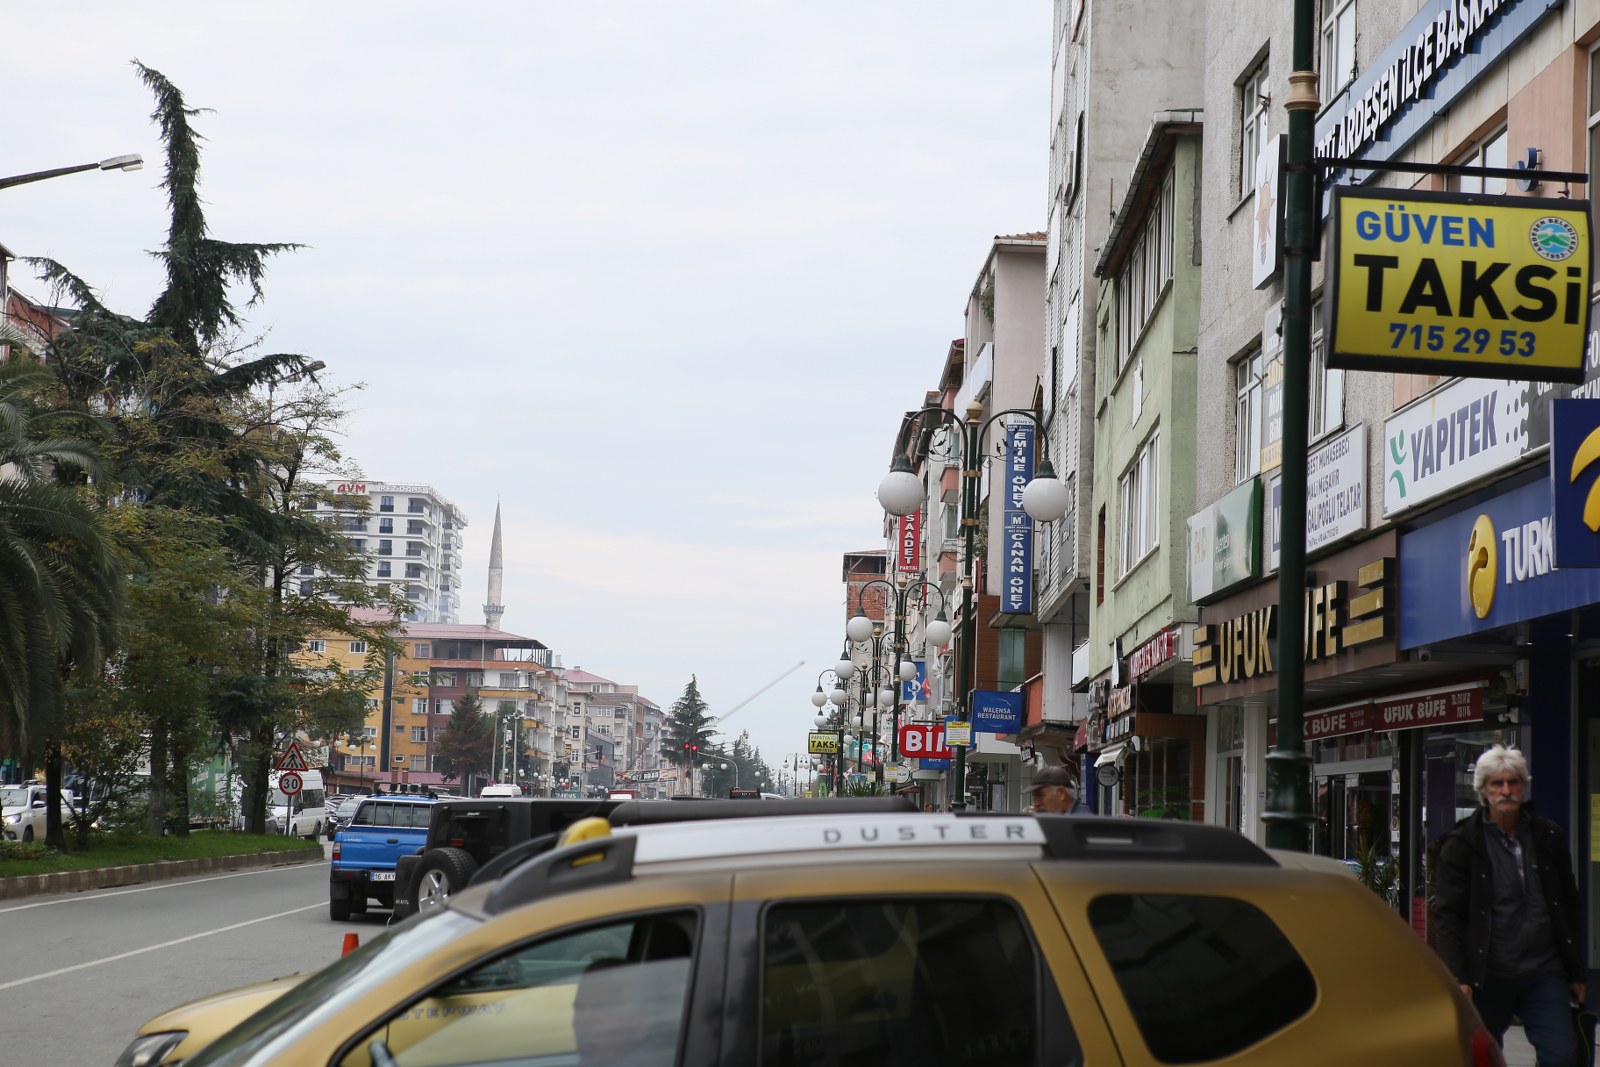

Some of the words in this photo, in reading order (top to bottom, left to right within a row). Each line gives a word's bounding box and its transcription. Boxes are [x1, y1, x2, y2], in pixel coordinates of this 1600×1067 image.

[1337, 59, 1399, 160] ARDEŞEN
[1401, 22, 1433, 104] İLÇE
[1356, 205, 1495, 249] GÜVEN
[1354, 254, 1583, 325] TAKSİ
[1389, 323, 1444, 352] 715
[1453, 326, 1491, 355] 29
[1499, 330, 1536, 358] 53
[1013, 432, 1027, 472] EMİNE
[1410, 389, 1498, 483] YAPITEK
[337, 483, 366, 493] AVM
[1011, 474, 1026, 509] ÖNEY
[904, 514, 915, 565] SAADET
[1010, 533, 1025, 573] CANAN
[1010, 576, 1024, 610] ÖNEY
[1219, 604, 1273, 685] UFUK
[977, 712, 1017, 721] RESTAURANT
[982, 706, 1012, 714] WALENSA
[1311, 713, 1347, 734] BÜFE
[1383, 704, 1414, 724] UFUK
[1417, 696, 1447, 718] BÜFE
[283, 778, 299, 790] 30
[823, 824, 1026, 844] DUSTER
[374, 872, 382, 880] 16
